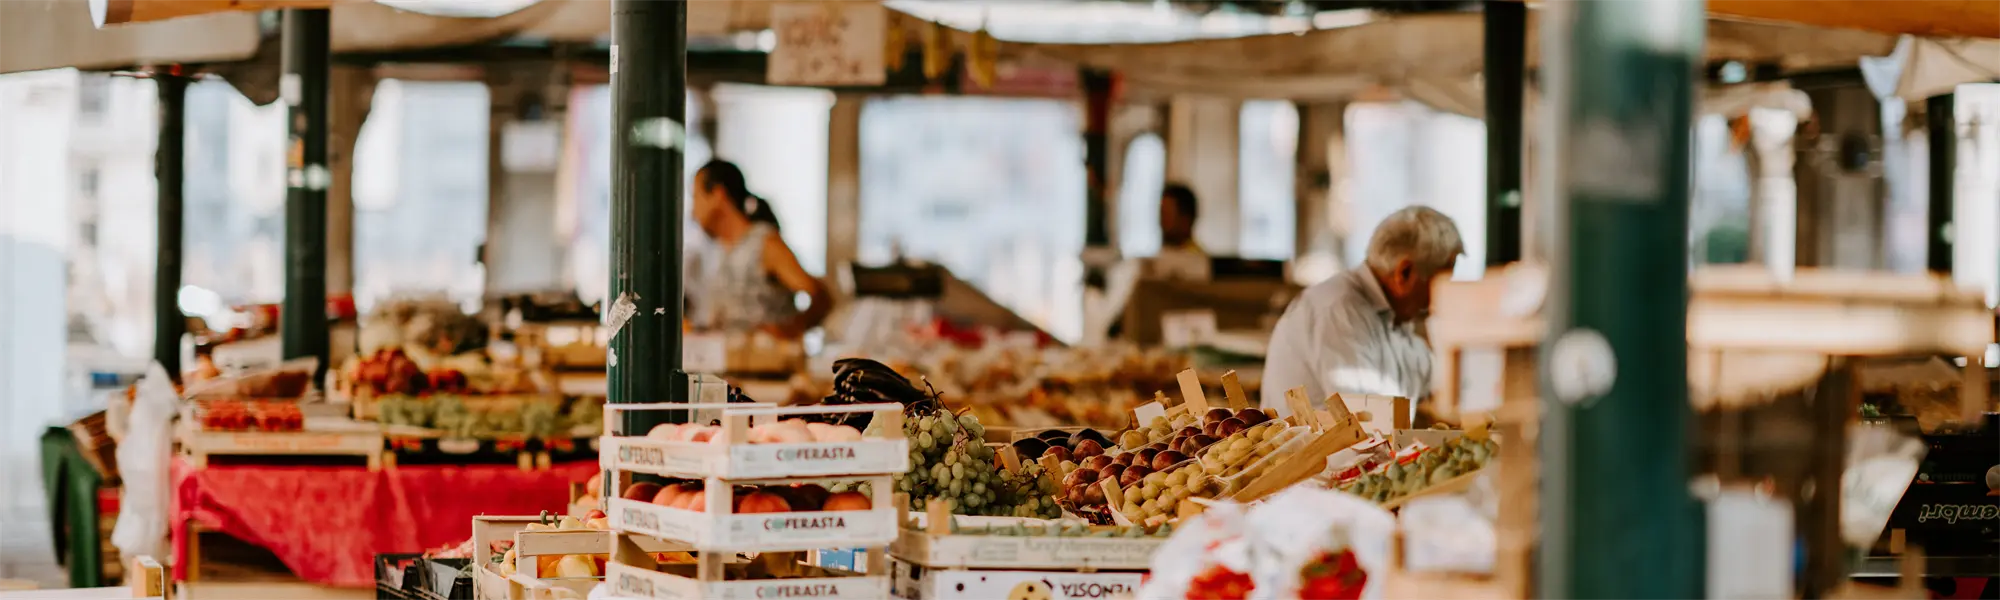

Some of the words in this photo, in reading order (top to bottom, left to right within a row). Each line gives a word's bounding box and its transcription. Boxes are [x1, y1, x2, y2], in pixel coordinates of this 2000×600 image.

[776, 447, 856, 461] COFERASTA
[1919, 504, 2000, 524] embri
[764, 517, 846, 532] COFERASTA
[756, 585, 839, 598] COFERASTA
